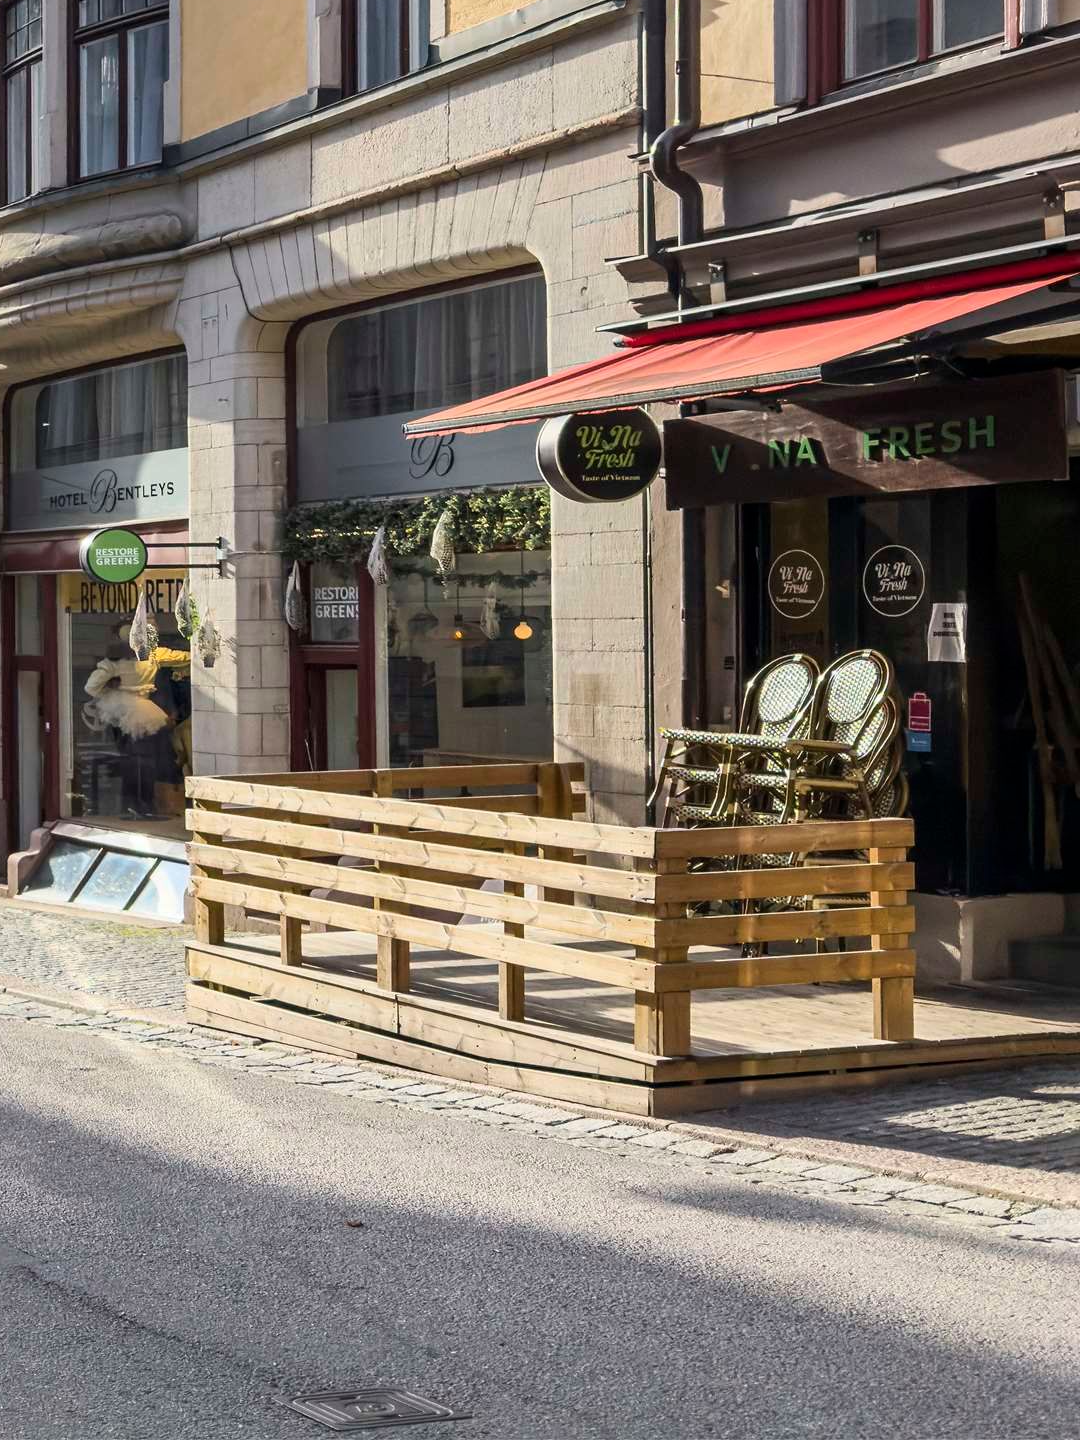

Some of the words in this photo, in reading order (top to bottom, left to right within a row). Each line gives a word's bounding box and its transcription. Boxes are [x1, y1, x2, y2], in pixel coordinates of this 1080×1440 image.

[576, 426, 604, 448] Vi
[608, 425, 642, 449] Na
[862, 415, 995, 462] FRESH
[585, 448, 635, 469] Fresh
[49, 492, 88, 509] HOTEL
[95, 547, 140, 556] RESTORE
[96, 557, 140, 566] GREENS
[782, 581, 808, 595] Fresh
[879, 578, 908, 592] Fresh
[80, 581, 138, 613] BEYOND
